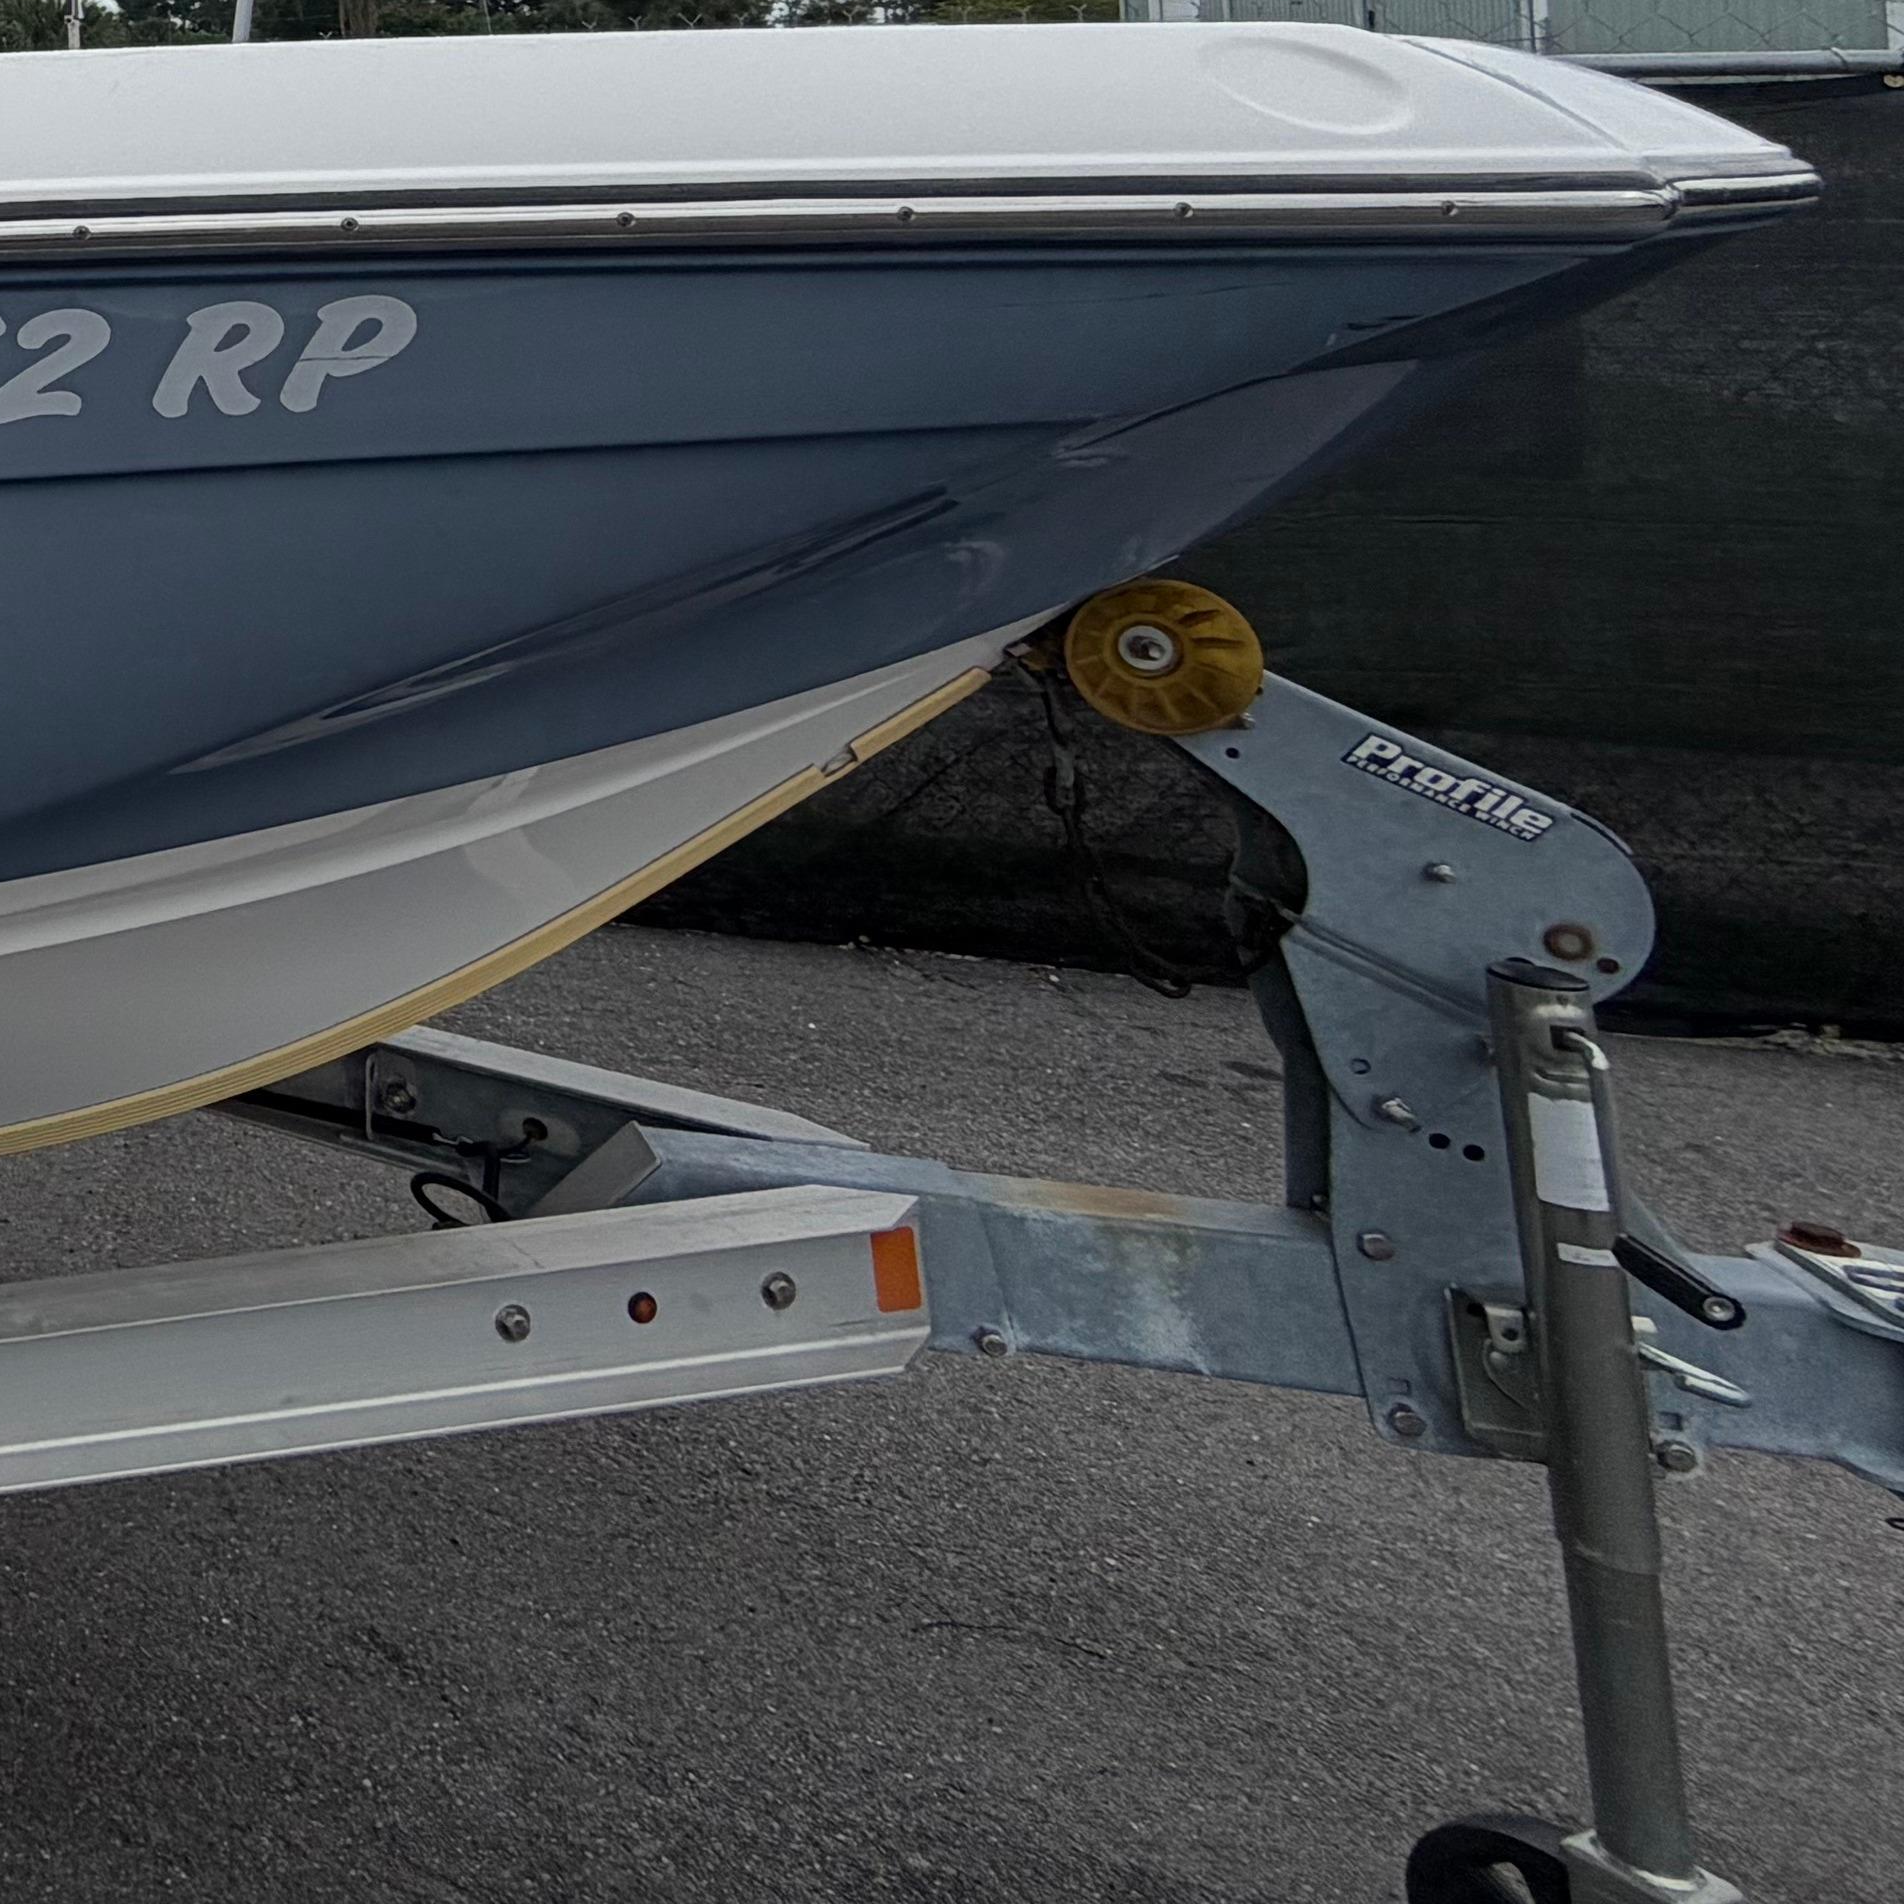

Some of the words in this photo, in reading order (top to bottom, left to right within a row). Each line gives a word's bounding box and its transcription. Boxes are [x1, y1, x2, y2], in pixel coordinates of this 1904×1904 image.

[151, 293, 418, 419] RP
[1345, 754, 1472, 814] PERFORMANCE
[1473, 807, 1536, 841] WINCH
[1351, 733, 1554, 834] Profile
